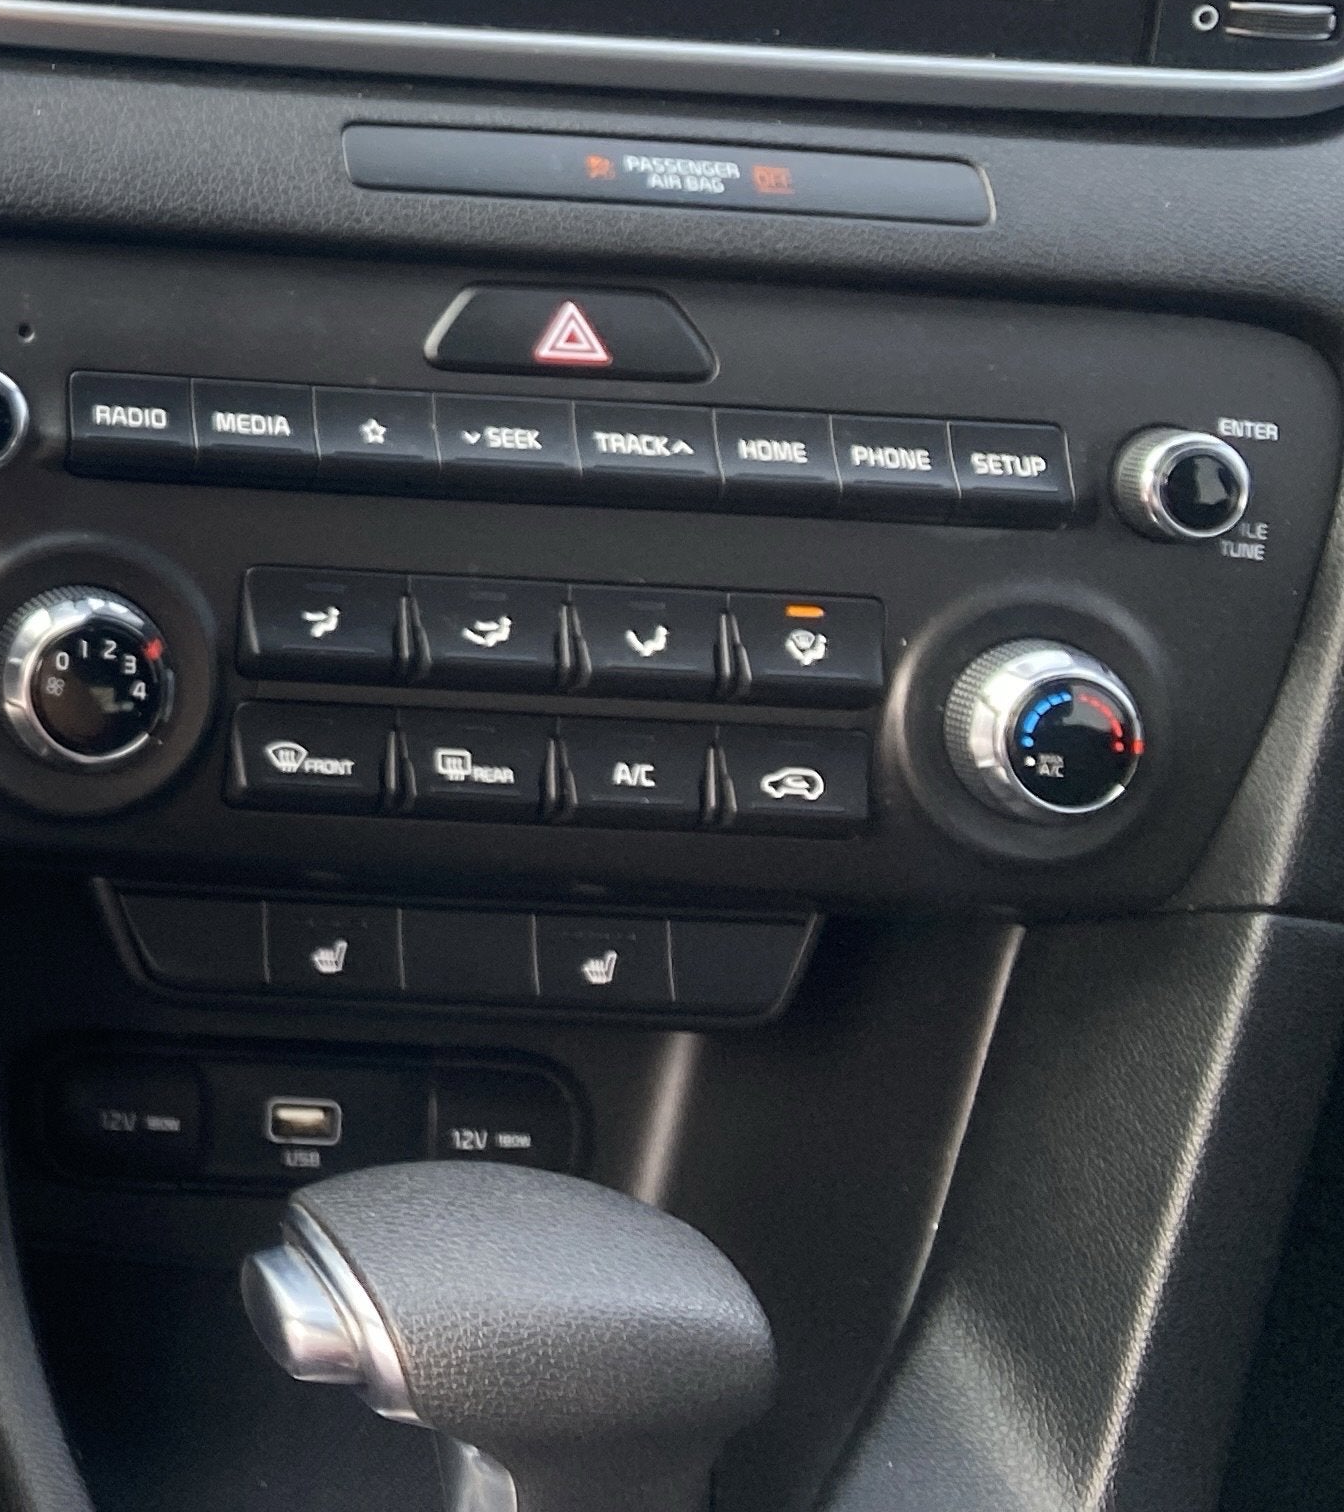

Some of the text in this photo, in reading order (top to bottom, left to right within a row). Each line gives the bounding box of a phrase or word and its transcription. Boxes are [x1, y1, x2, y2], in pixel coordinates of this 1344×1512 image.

[623, 154, 742, 180] PASSENGER
[647, 172, 725, 194] AIR BAG
[92, 403, 169, 432] RADIO
[215, 410, 292, 438] MEDIA
[1218, 416, 1279, 441] ENTER
[485, 426, 543, 452] SEEK
[595, 431, 670, 458] TRACK
[737, 438, 809, 466] HOME
[851, 445, 933, 474] PHONE
[971, 451, 1048, 480] SETUP
[1239, 521, 1269, 540] ILE
[1220, 538, 1266, 561] TUNE
[80, 639, 89, 659] 1
[102, 639, 118, 660] 2
[55, 651, 70, 672] 0
[123, 653, 137, 675] 3
[132, 680, 147, 701] 4
[303, 757, 356, 777] FRONT
[472, 764, 515, 785] REAR
[613, 760, 656, 789] A/C
[452, 1128, 488, 1150] 12V
[282, 1149, 321, 1170] USB
